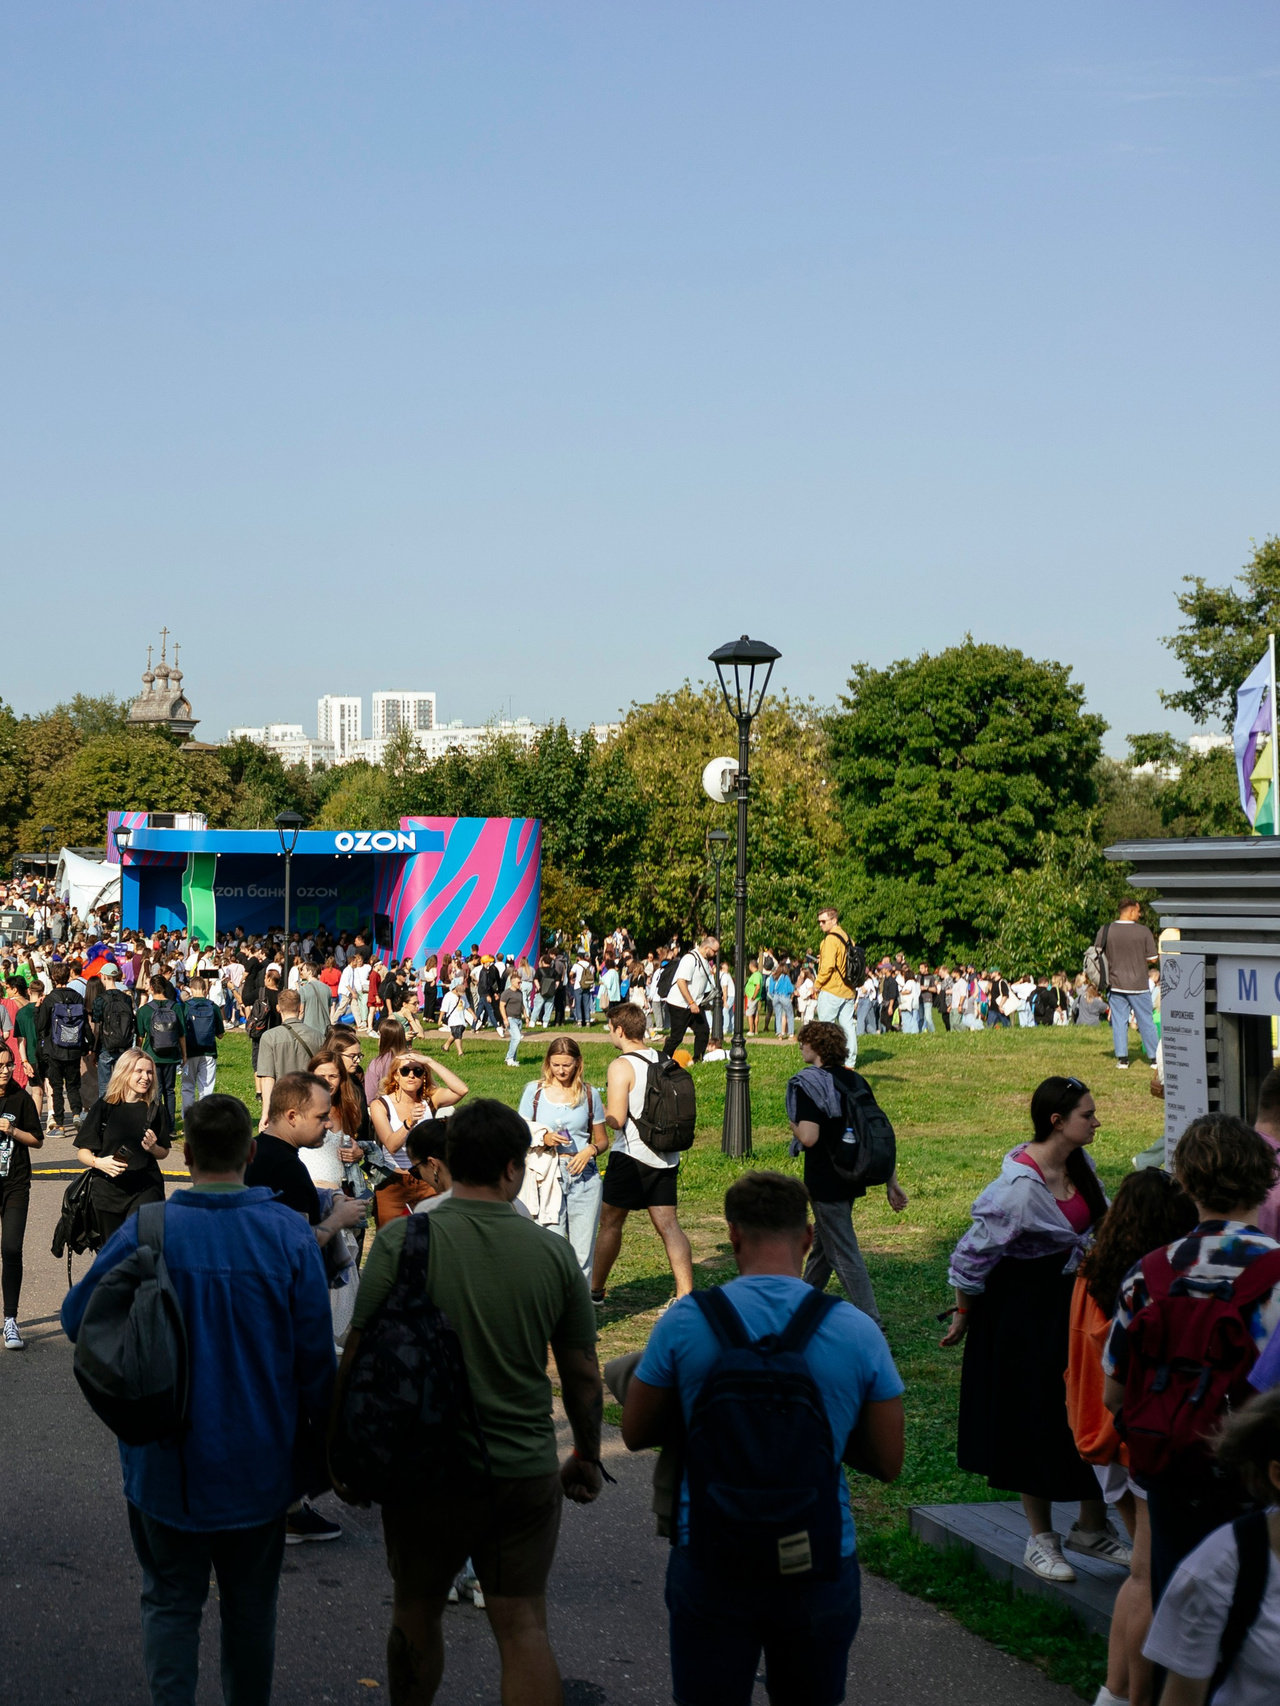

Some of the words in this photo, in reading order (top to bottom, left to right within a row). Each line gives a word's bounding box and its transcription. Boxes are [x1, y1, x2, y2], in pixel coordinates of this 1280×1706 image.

[334, 831, 417, 852] OZON
[215, 886, 244, 897] zon
[247, 884, 287, 897] банк
[296, 887, 338, 898] OZON
[1170, 1010, 1195, 1021] МОРОЖЕНОЕ
